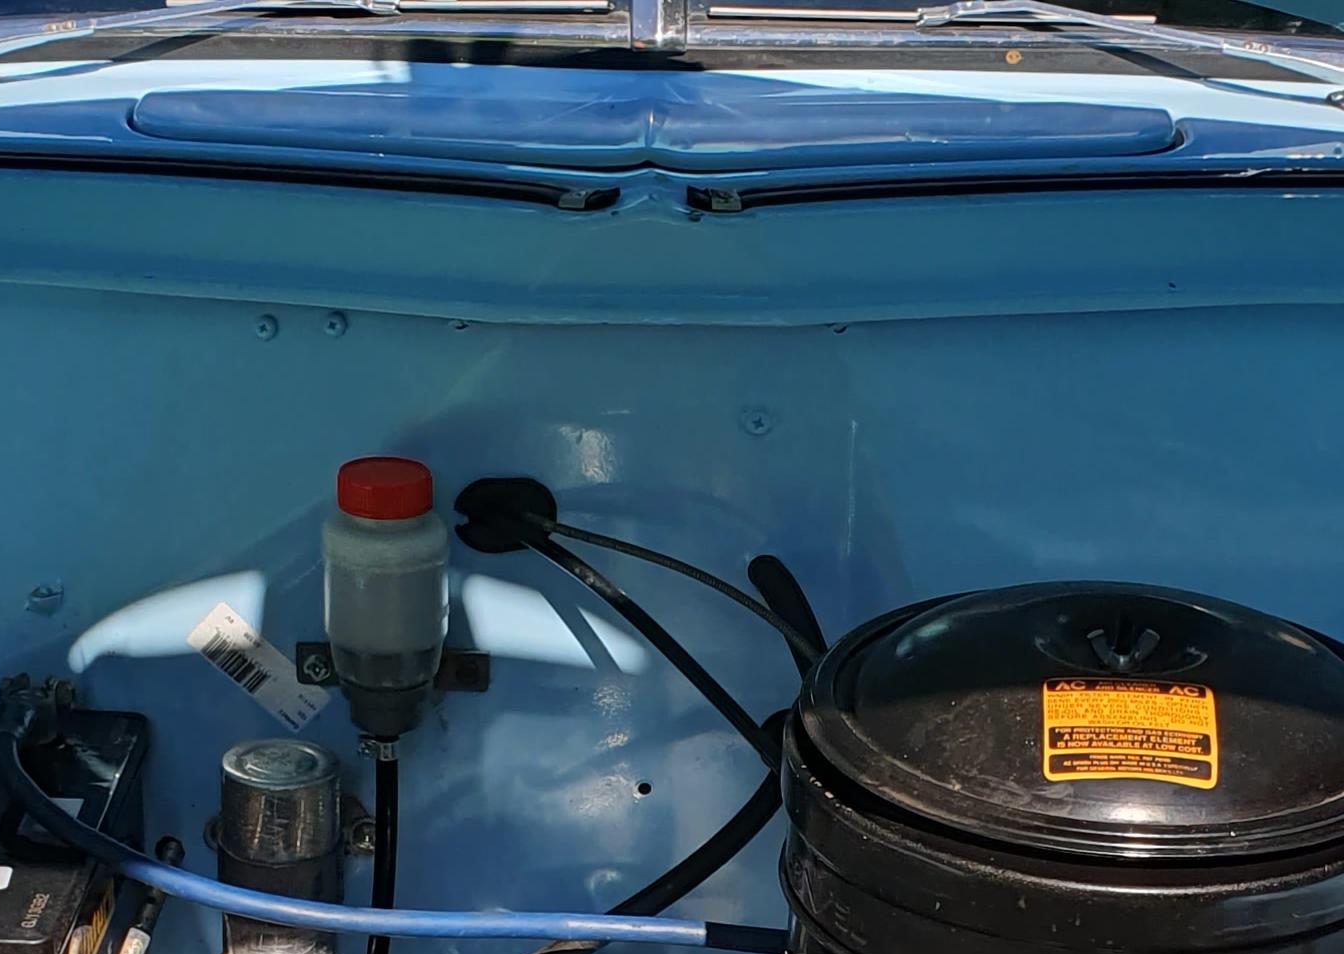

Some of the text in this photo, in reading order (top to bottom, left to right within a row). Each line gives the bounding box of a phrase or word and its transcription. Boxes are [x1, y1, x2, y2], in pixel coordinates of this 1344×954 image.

[1055, 681, 1086, 690] AC
[1169, 686, 1200, 697] AC
[1072, 733, 1148, 742] REPLACEMENT
[1149, 735, 1198, 746] ELEMENT
[1091, 741, 1141, 749] AVAILABLE
[1155, 743, 1177, 751] LOW
[1177, 745, 1205, 754] COST.
